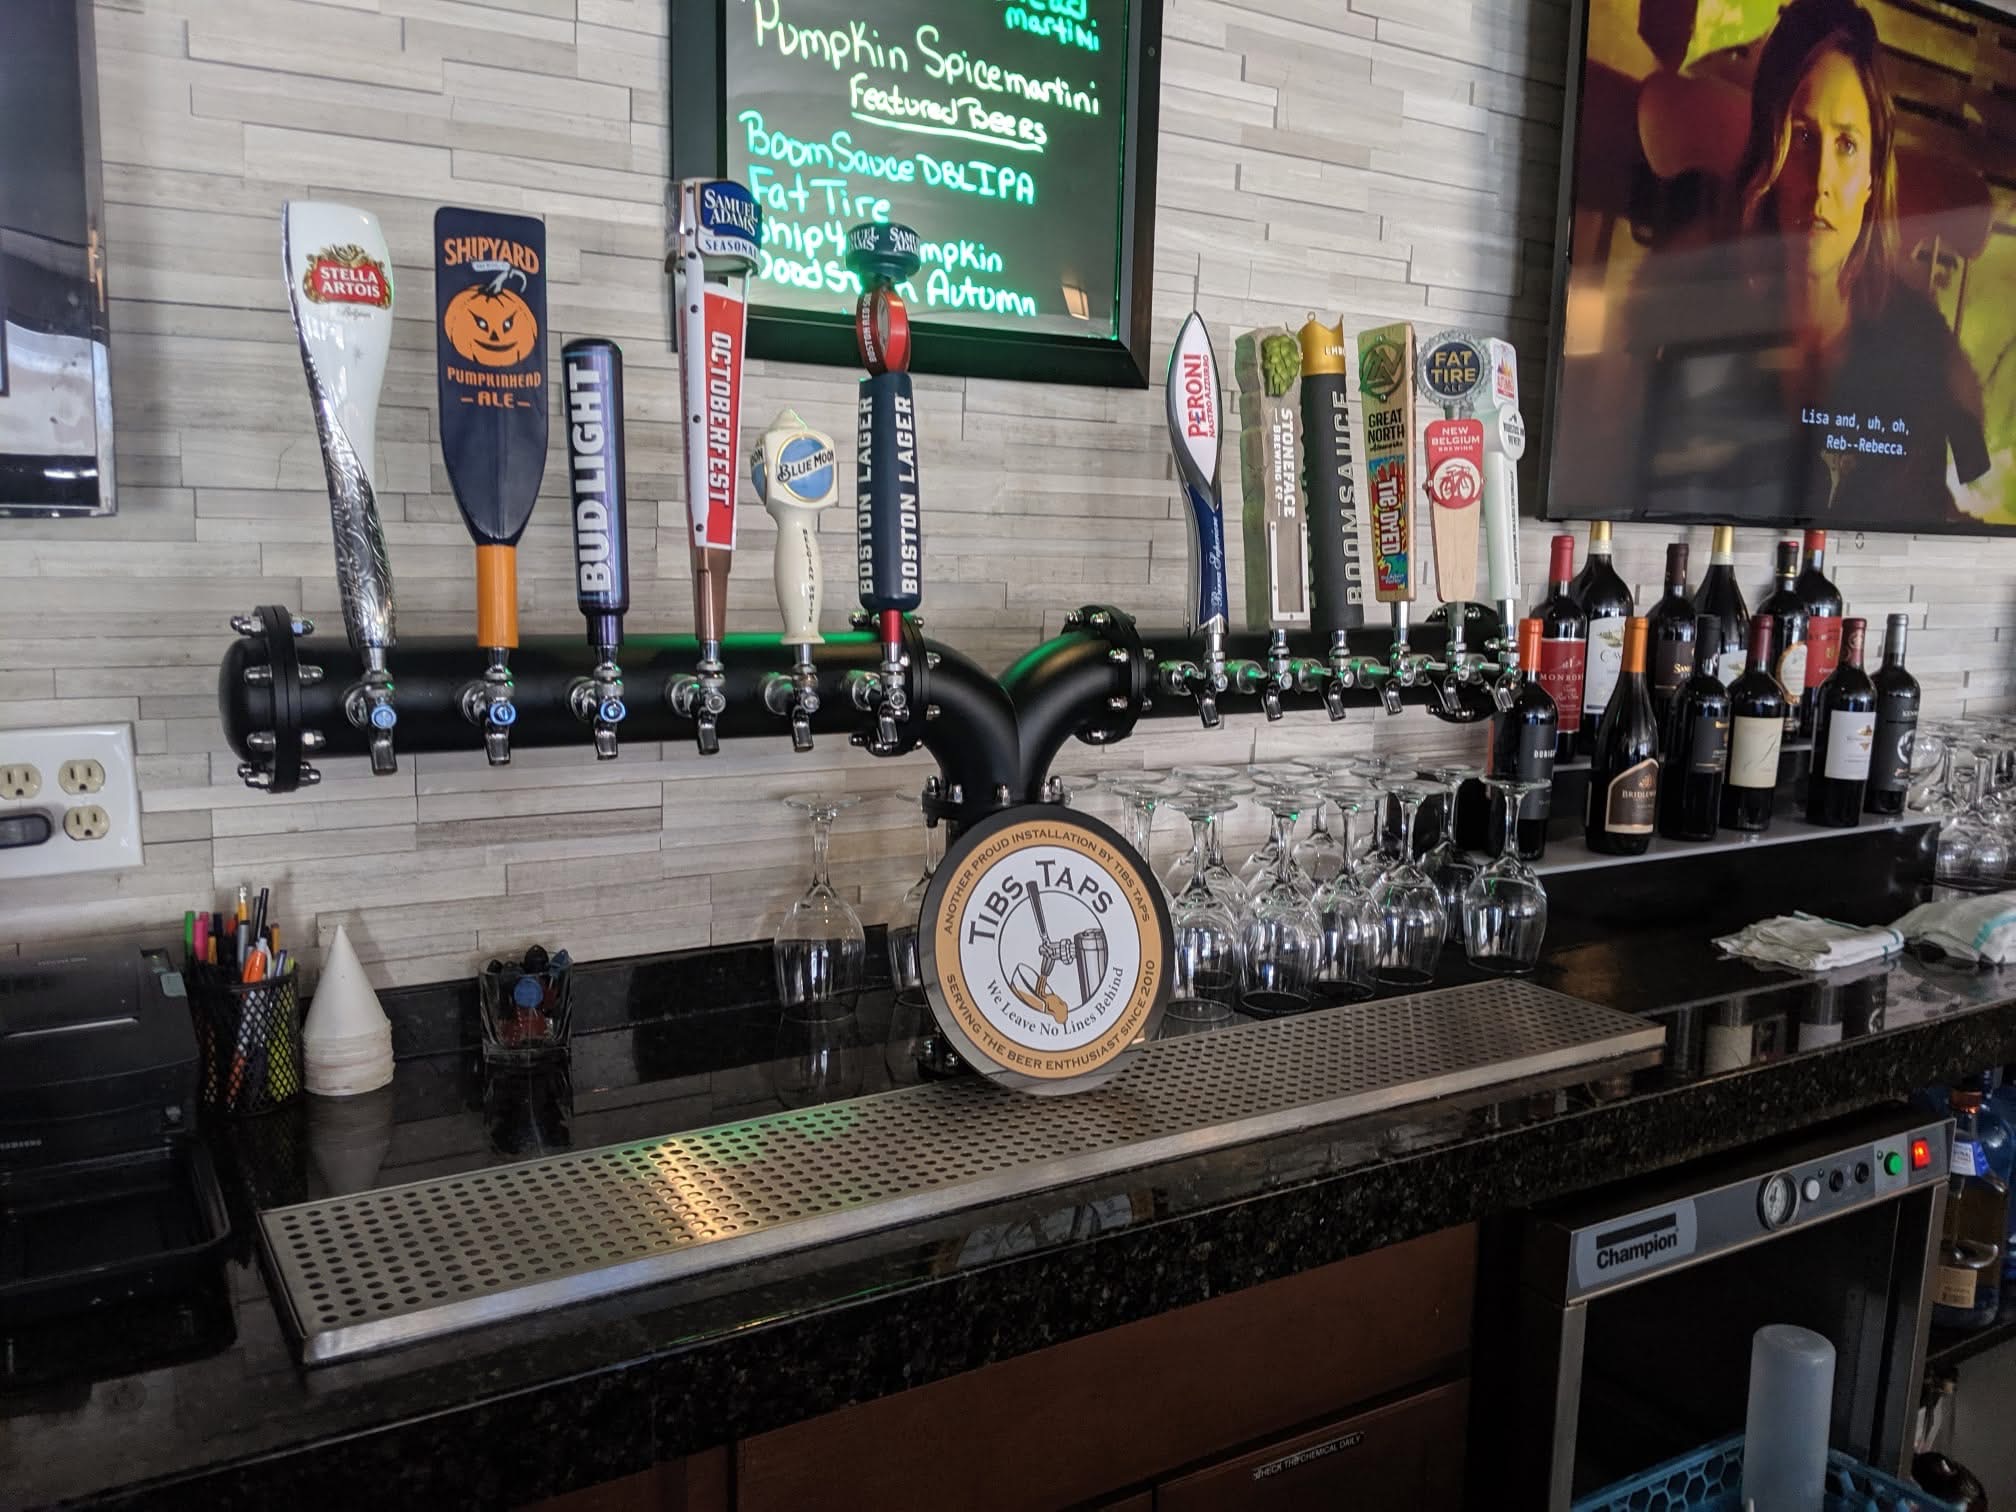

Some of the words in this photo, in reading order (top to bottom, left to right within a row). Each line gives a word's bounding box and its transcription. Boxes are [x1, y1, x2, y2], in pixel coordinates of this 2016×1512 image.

[850, 72, 958, 125] Featured
[704, 188, 758, 223] SAMUEL
[749, 165, 810, 214] Fat
[810, 178, 890, 223] Tire
[710, 207, 756, 237] ADAMS
[320, 266, 379, 285] STELLA
[443, 235, 540, 275] SHIPYARD
[321, 280, 380, 298] ARTOIS
[926, 267, 1036, 317] Autumn
[1430, 367, 1476, 384] TIRE
[1435, 351, 1473, 367] FAT
[708, 330, 732, 507] OCTOBERFEST
[1184, 353, 1208, 439] PERONI
[1368, 407, 1402, 428] GREAT
[1802, 408, 1829, 425] Lisa
[1835, 412, 1860, 431] and,
[1867, 415, 1885, 433] uh,
[1892, 418, 1910, 436] oh,
[568, 362, 607, 494] LIGHT
[858, 396, 873, 483] LAGER
[895, 395, 915, 483] LAGER
[1273, 424, 1282, 481] BREWING
[1368, 424, 1405, 443] NORTH
[1431, 435, 1480, 446] BELGIUM
[1442, 426, 1469, 436] NEW
[1281, 408, 1296, 518] STONEFACE
[577, 500, 612, 593] BUD
[859, 494, 874, 594] BOSTON
[900, 494, 918, 594] BOSTON
[944, 867, 973, 935] ANOTHER
[972, 838, 1010, 871] PROUD
[1012, 828, 1098, 852] INSTALLATION
[1098, 848, 1114, 863] BY
[1113, 860, 1136, 887] TIBS
[1132, 886, 1150, 923] TAPS
[968, 875, 1024, 945] TIBS
[1035, 858, 1113, 915] TAPS
[946, 974, 981, 1034] SERVING
[982, 1030, 1007, 1056] THE
[1007, 1048, 1042, 1070] BEER
[1046, 1035, 1120, 1071] ENTHUSIAST
[1121, 998, 1147, 1036] SINCE
[1142, 960, 1156, 999] 2010
[987, 979, 1003, 1003] We
[1001, 1001, 1037, 1034] Leave
[1040, 1023, 1059, 1037] No
[1063, 1016, 1097, 1036] Lines
[1095, 967, 1124, 1017] Behind
[1597, 1233, 1677, 1269] Champion
